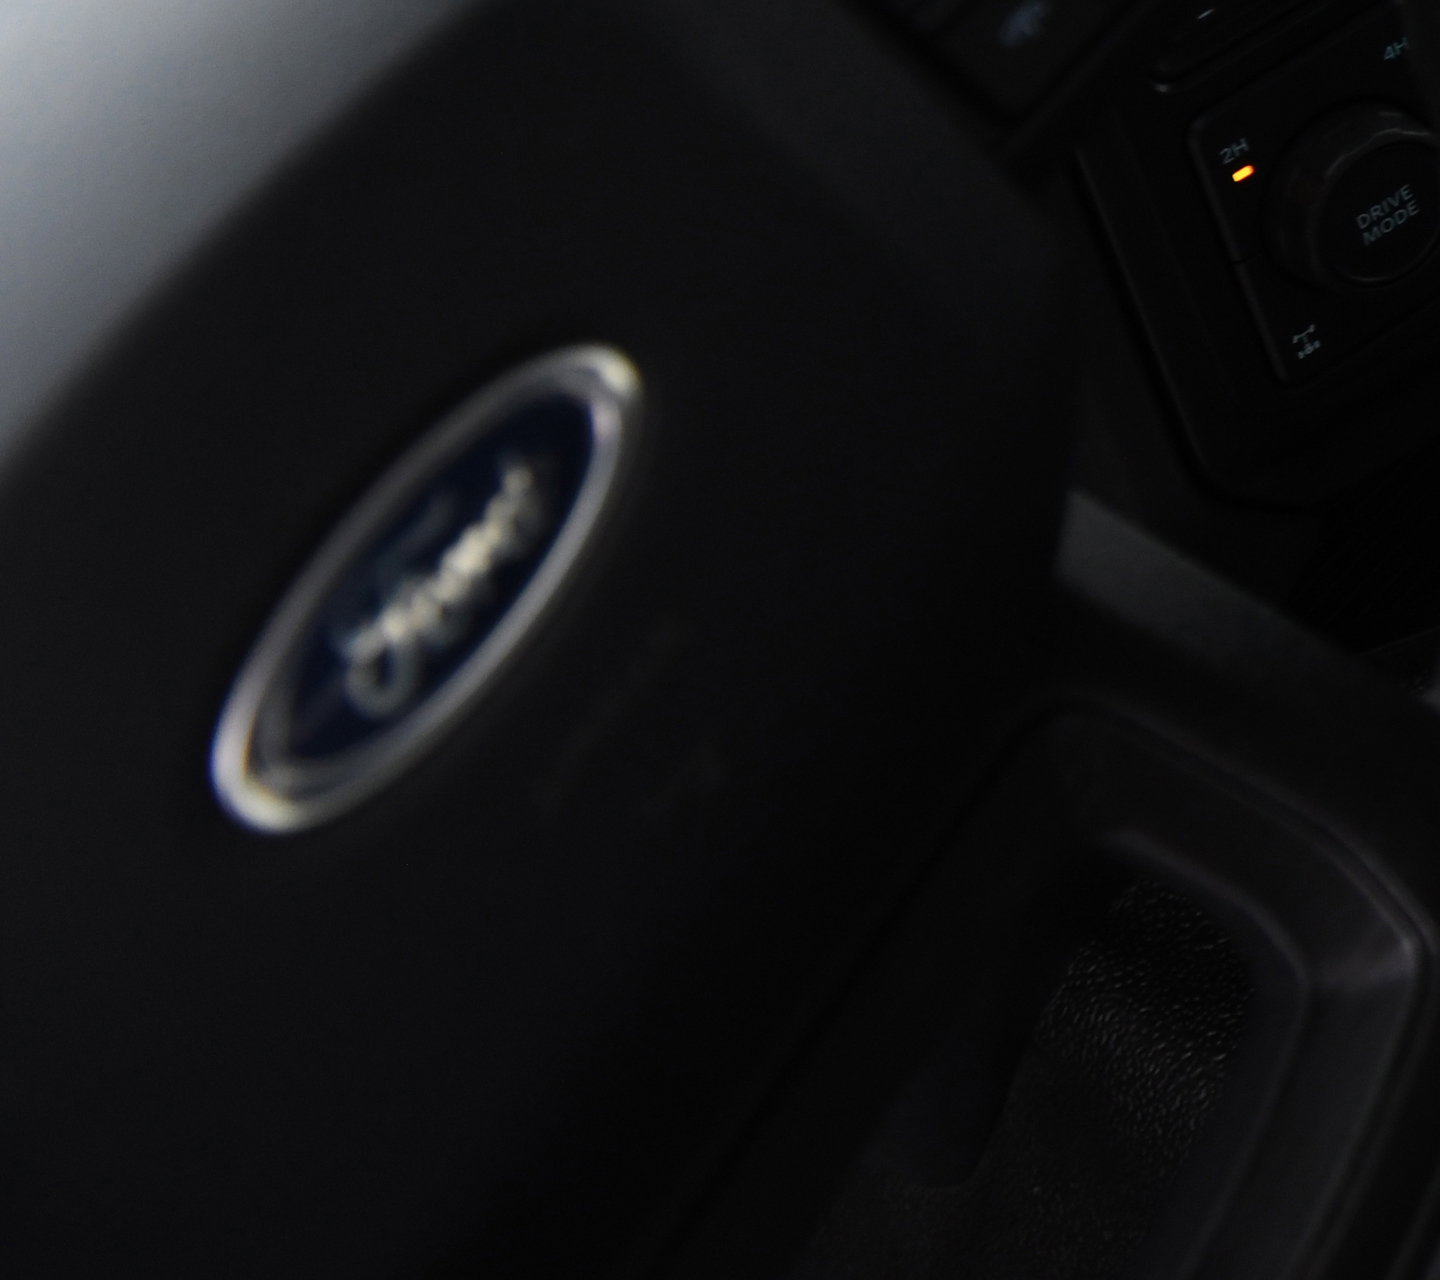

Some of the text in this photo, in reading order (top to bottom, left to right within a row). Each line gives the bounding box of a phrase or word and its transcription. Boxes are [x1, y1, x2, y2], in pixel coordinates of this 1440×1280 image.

[1218, 137, 1250, 166] 2H
[1354, 183, 1415, 231] DRIVE
[1361, 199, 1421, 247] MODE
